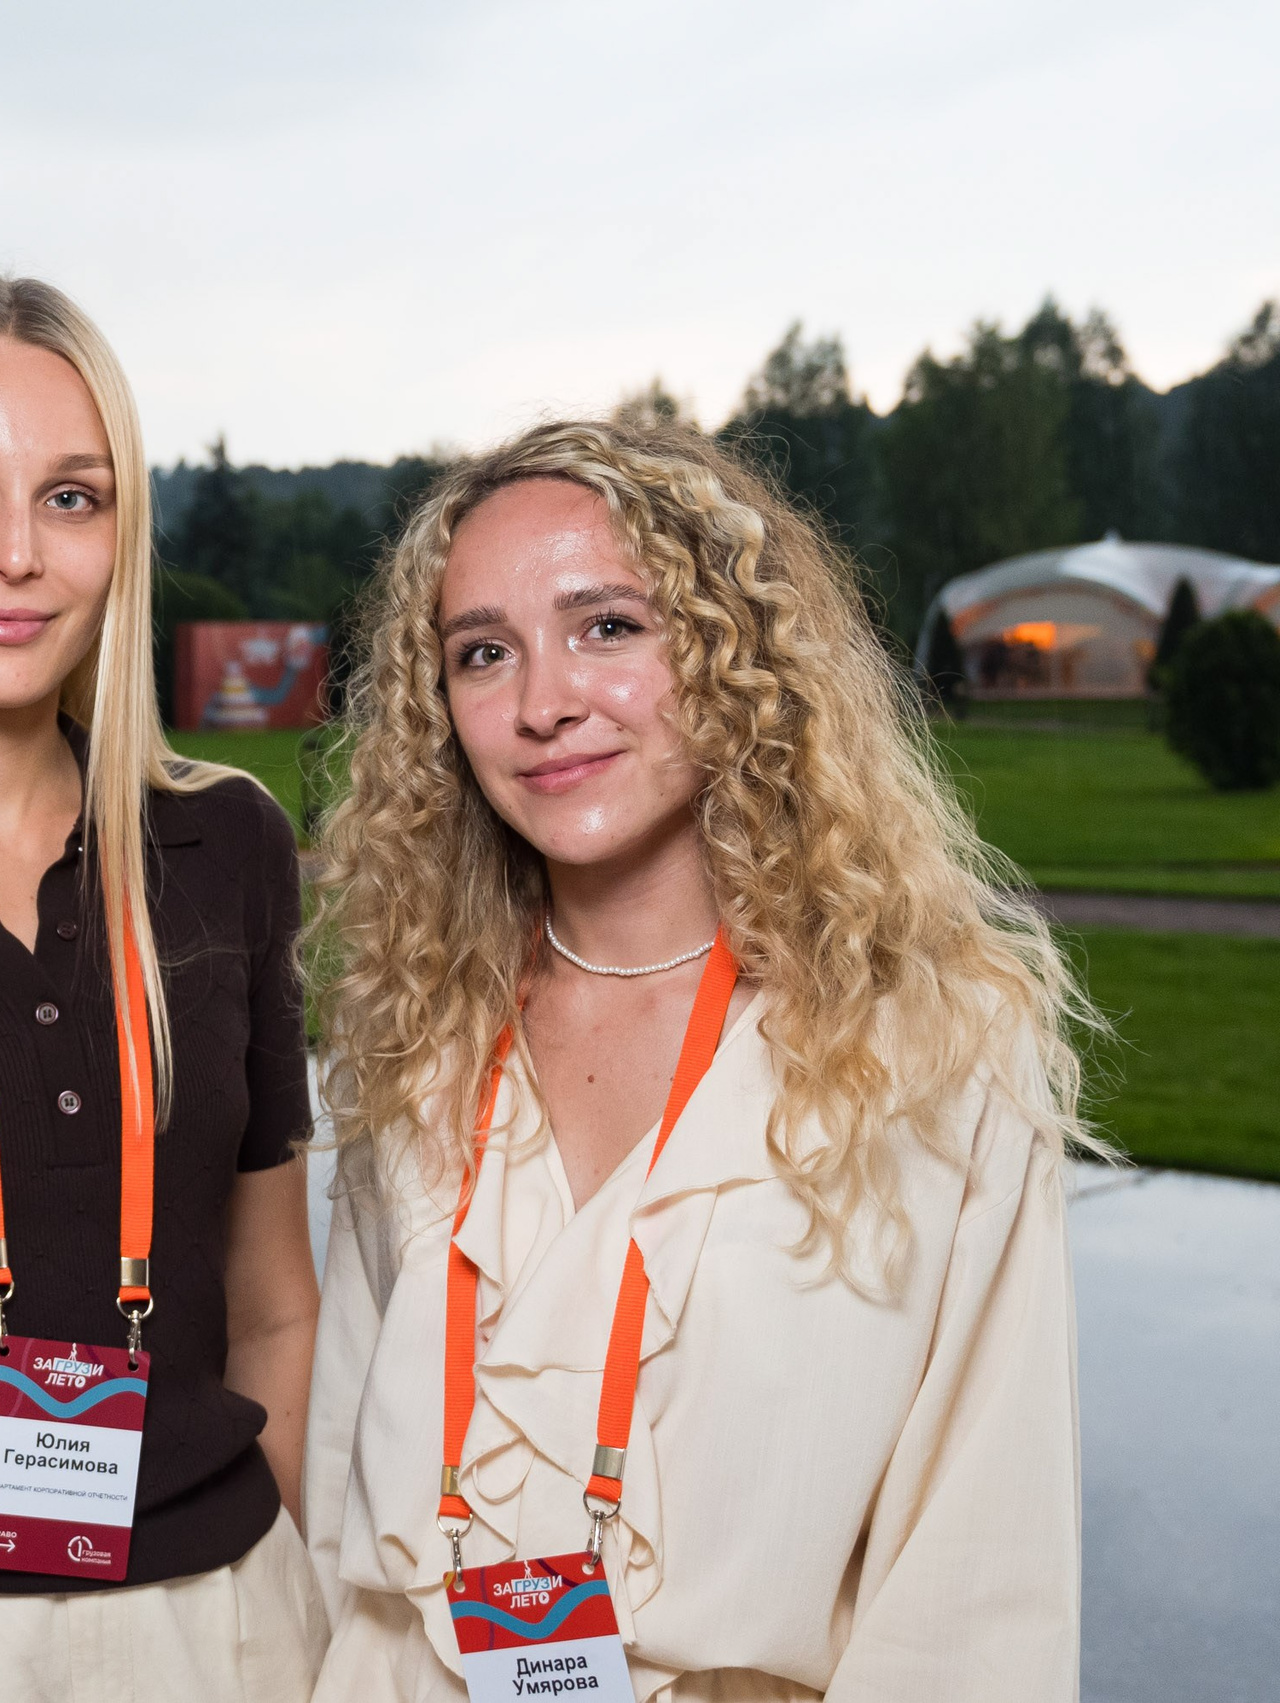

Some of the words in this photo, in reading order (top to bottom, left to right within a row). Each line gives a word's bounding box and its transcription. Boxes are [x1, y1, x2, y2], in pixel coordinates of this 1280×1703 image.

[33, 1357, 104, 1376] ЗАГРУЗИ
[44, 1373, 86, 1388] ЛЕТО
[36, 1432, 90, 1453] Юлия
[4, 1449, 118, 1475] Герасимова
[33, 1486, 86, 1497] КОРПОРАТИВНОЙ
[493, 1575, 563, 1596] ЗАГРУЗИ
[510, 1592, 550, 1609] ЛЕТО
[516, 1655, 588, 1678] Динара
[513, 1675, 599, 1696] Умярова
